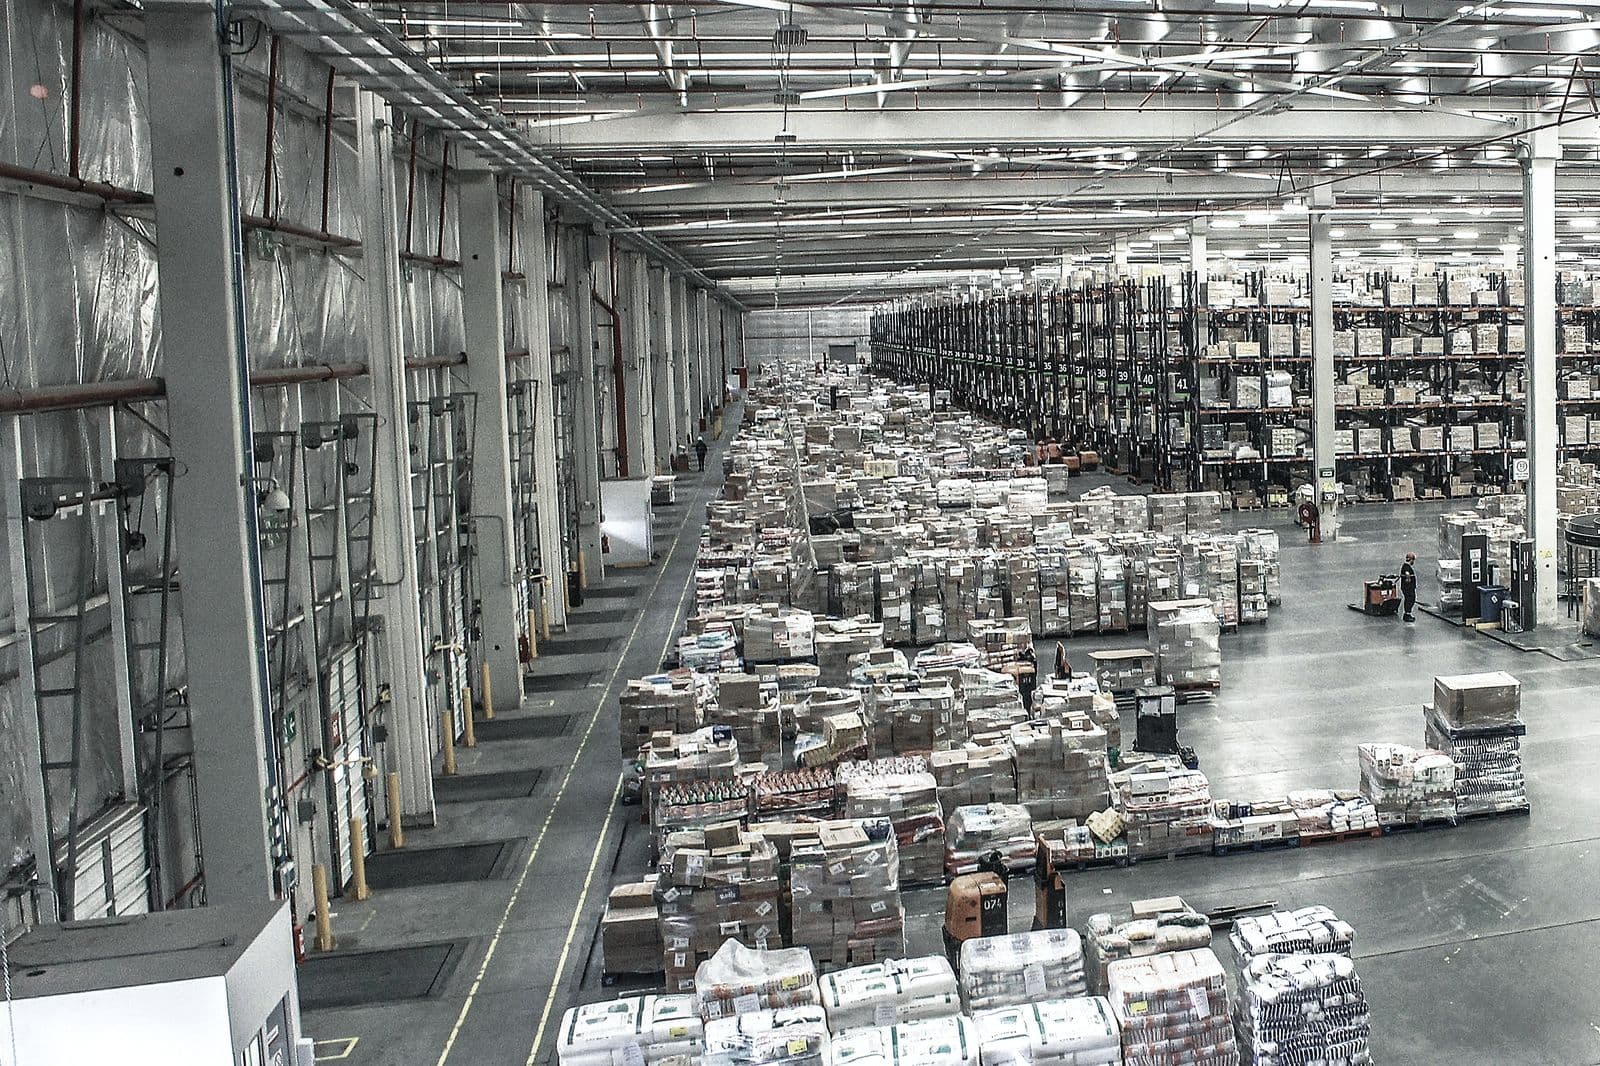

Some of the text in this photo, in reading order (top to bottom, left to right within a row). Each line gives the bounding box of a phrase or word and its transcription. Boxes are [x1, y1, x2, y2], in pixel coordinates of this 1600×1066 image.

[1016, 358, 1024, 367] 33
[1043, 362, 1052, 370] 35
[1058, 364, 1067, 373] 36
[1075, 366, 1084, 375] 37
[1097, 368, 1107, 378] 38
[1118, 371, 1128, 381] 39
[1142, 374, 1154, 385] 40
[1176, 378, 1188, 390] 41
